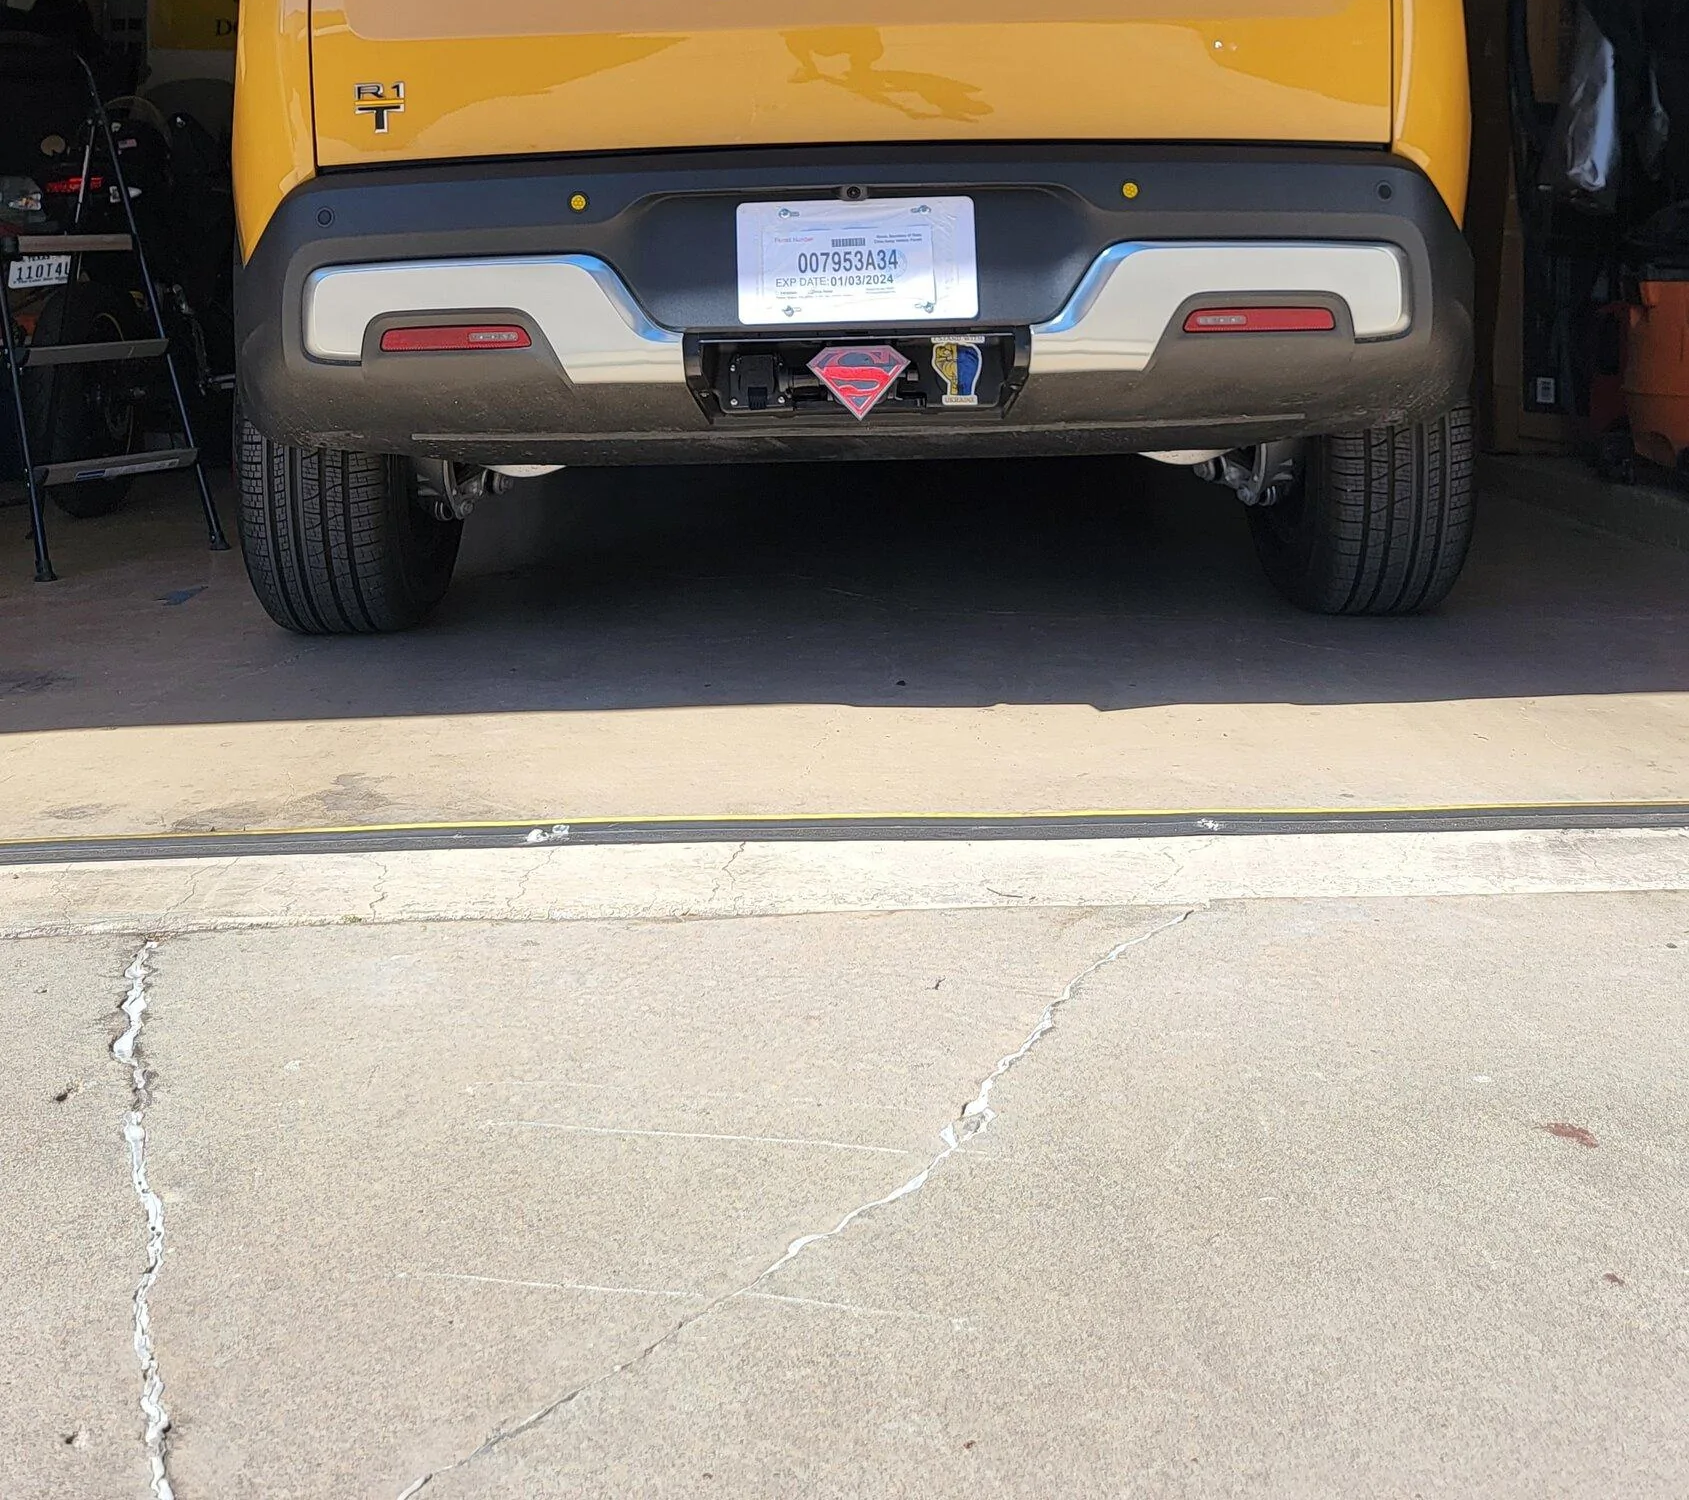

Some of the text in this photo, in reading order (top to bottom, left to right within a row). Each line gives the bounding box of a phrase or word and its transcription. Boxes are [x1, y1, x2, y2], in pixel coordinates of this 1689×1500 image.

[798, 249, 899, 274] 007953A34
[775, 278, 797, 288] EXP
[830, 274, 894, 287] 01/03/2024
